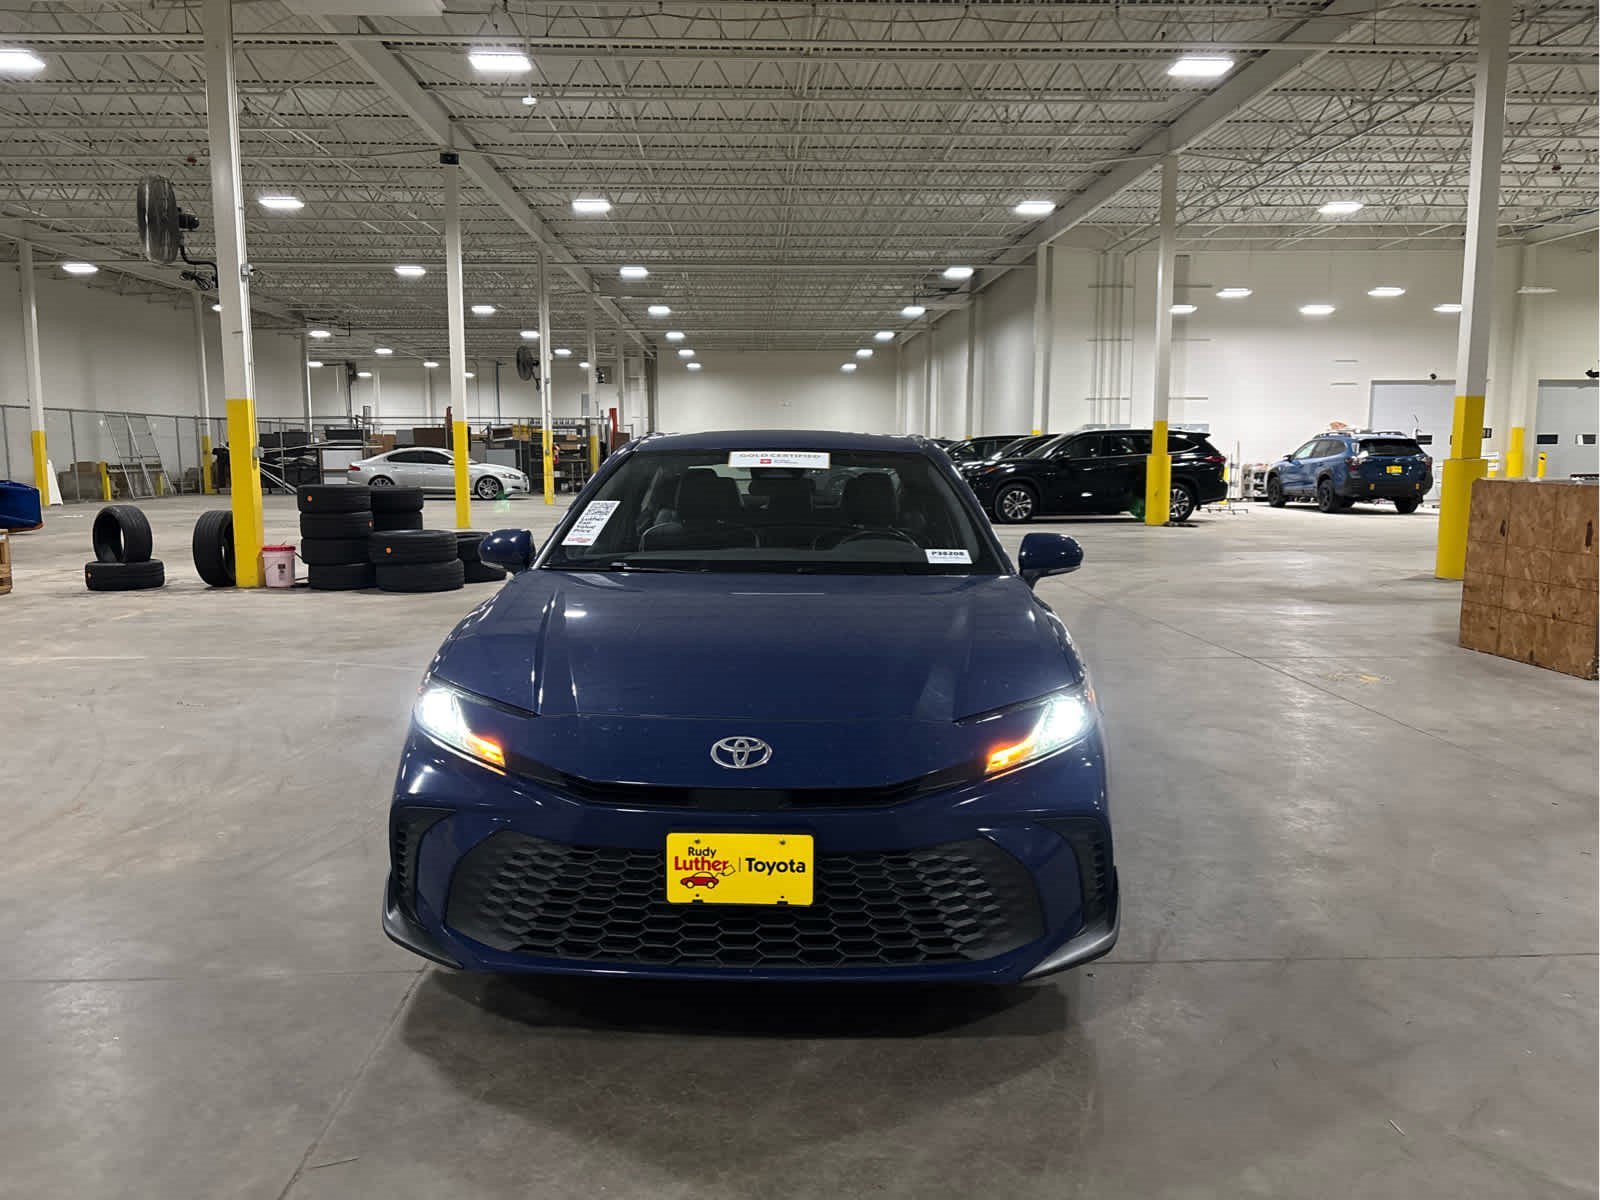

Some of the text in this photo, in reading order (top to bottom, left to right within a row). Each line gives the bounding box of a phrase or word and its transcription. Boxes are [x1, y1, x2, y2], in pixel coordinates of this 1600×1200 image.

[688, 846, 717, 858] Rudy
[674, 856, 806, 876] Luther Toyota
